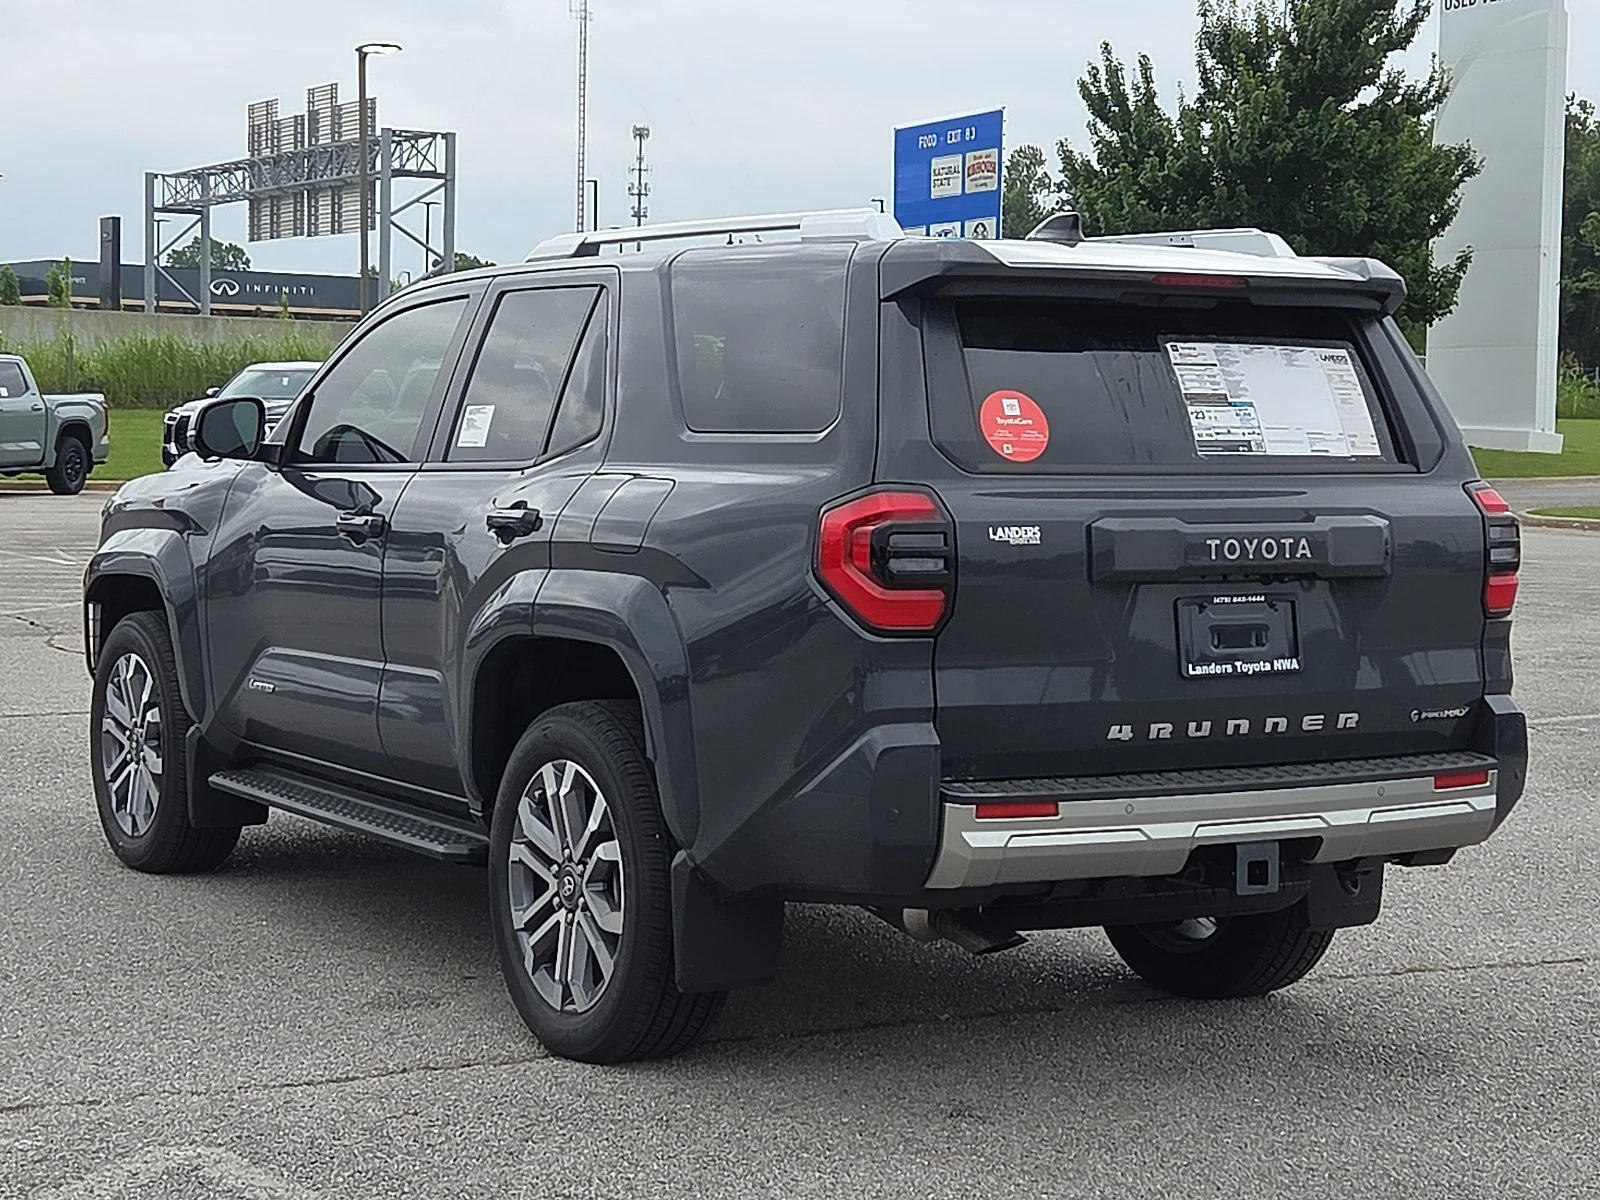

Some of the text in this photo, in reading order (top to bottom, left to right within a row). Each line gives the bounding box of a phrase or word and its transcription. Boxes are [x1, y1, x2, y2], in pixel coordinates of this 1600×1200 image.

[919, 134, 937, 149] FOOD
[933, 165, 960, 177] NATURAL
[933, 177, 951, 188] STATE
[246, 283, 315, 296] INFINITI
[988, 526, 1041, 541] LANDERS
[1206, 538, 1312, 560] TOYOTA
[1188, 658, 1300, 675] Landers Toyota NWA
[1106, 712, 1360, 741] 4RUNNER
